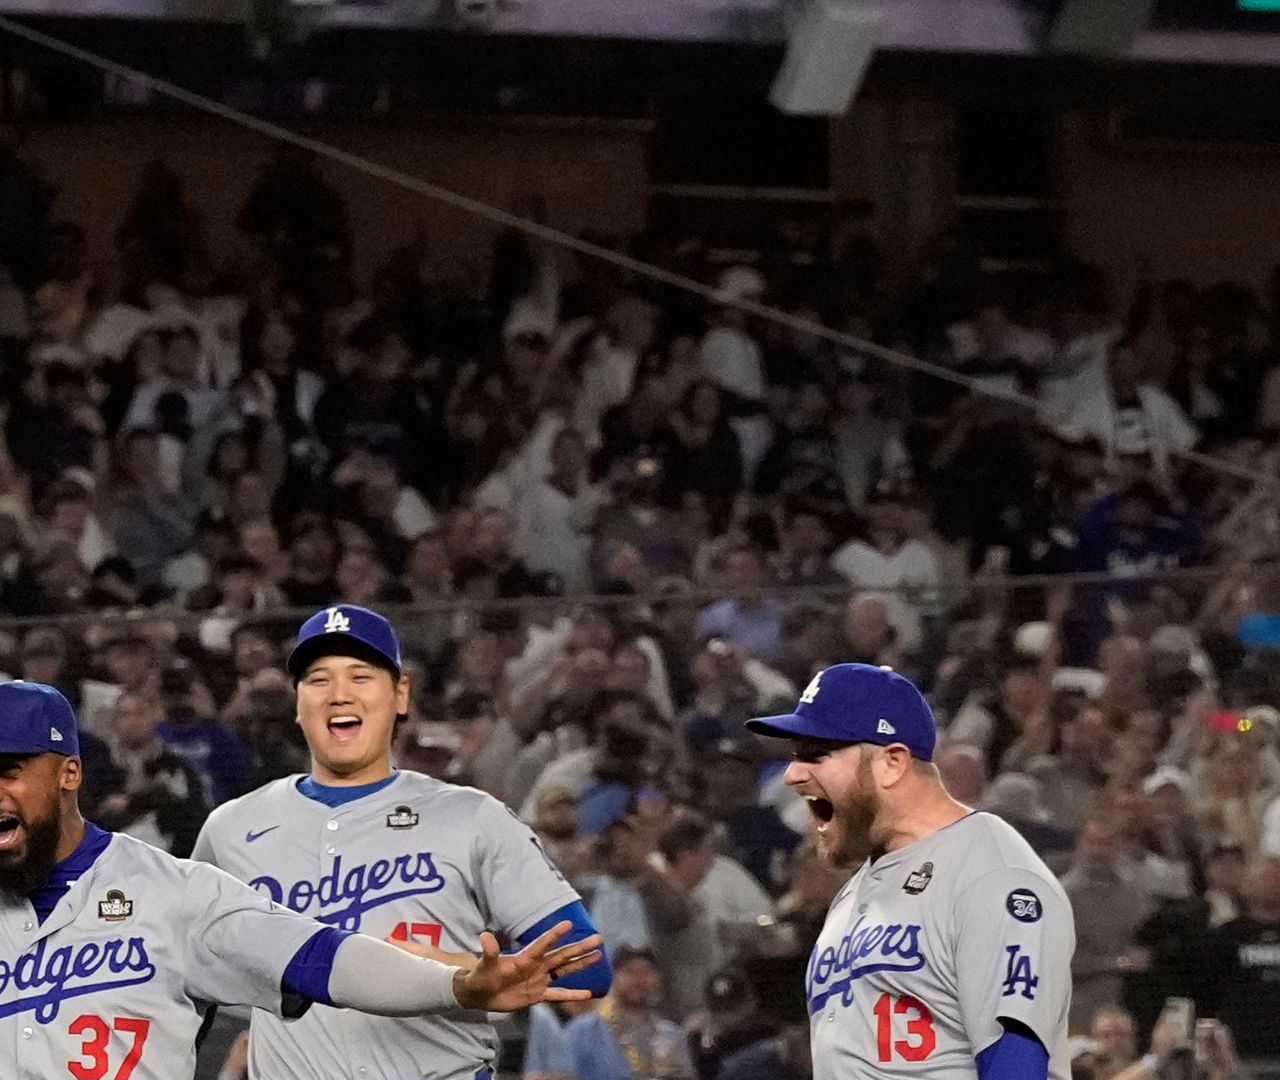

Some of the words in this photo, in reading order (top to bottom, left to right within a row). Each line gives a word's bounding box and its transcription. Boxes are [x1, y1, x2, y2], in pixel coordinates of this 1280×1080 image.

[324, 608, 350, 633] LA
[1014, 900, 1037, 918] 34
[1002, 945, 1039, 1000] LA
[873, 992, 936, 1062] 13
